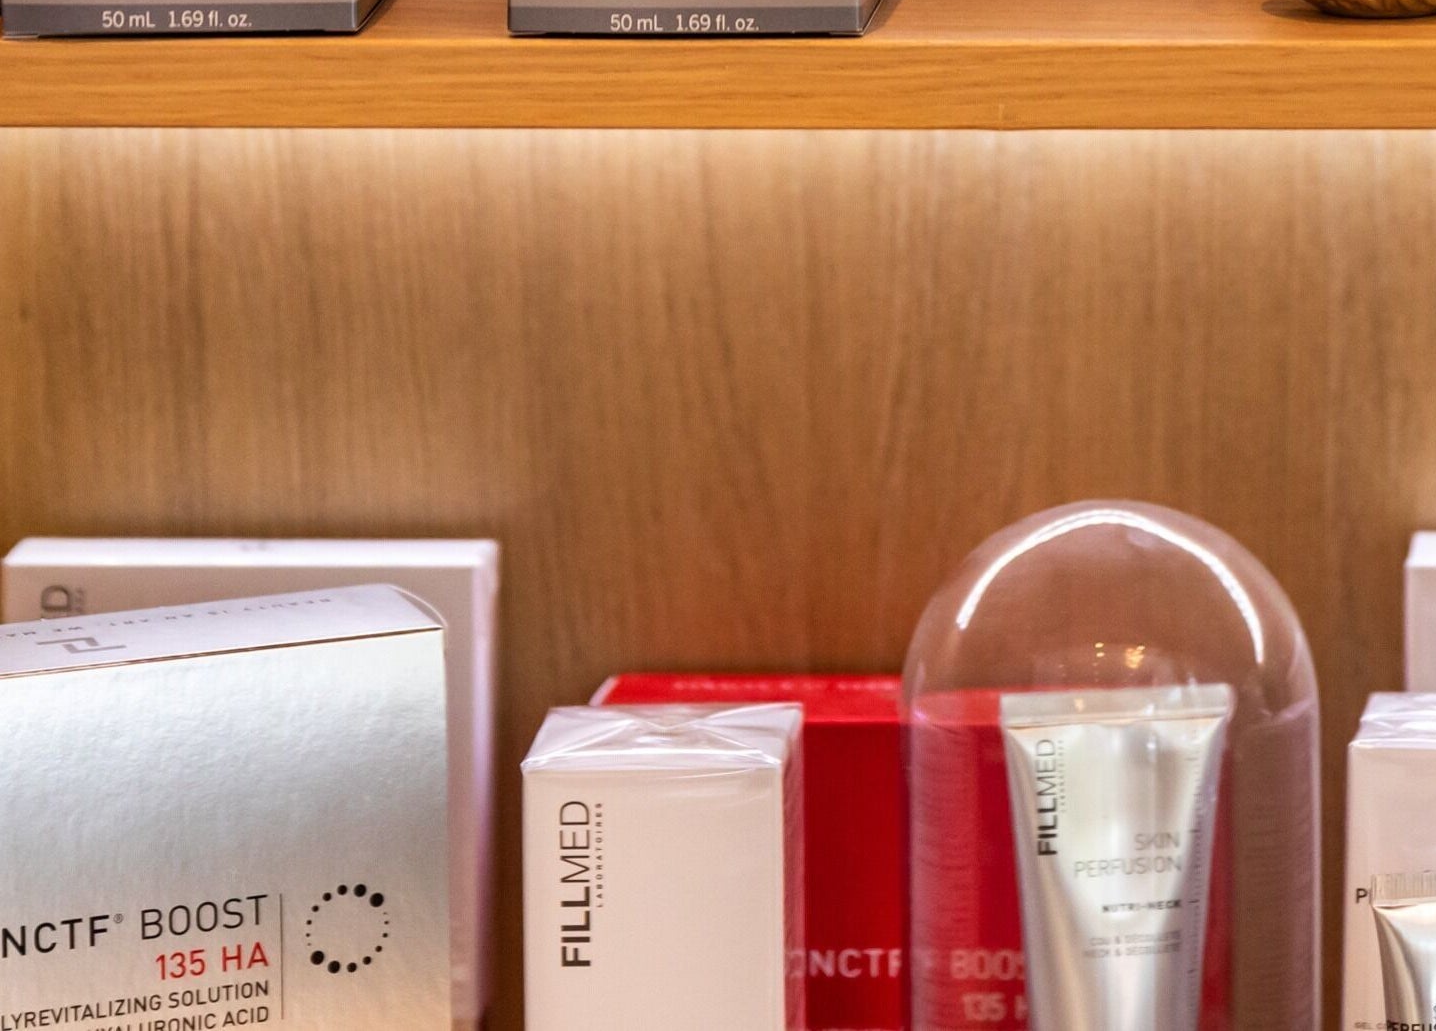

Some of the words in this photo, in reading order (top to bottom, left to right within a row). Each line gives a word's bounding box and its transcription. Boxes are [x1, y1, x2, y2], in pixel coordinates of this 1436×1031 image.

[102, 11, 125, 28] 50
[128, 11, 156, 28] mL
[168, 10, 203, 28] 1.69
[207, 10, 223, 27] fl.
[227, 13, 252, 27] oz.
[610, 14, 633, 31] 50
[637, 14, 663, 31] mL
[676, 14, 711, 31] 1.69
[715, 14, 730, 31] fl.
[735, 17, 760, 31] oz.
[1035, 739, 1058, 856] FILLMED
[559, 799, 592, 967] FILLMED
[140, 894, 269, 940] BOOST
[155, 949, 207, 981] 135
[220, 942, 270, 972] HA
[168, 980, 269, 1009] SOLUTION
